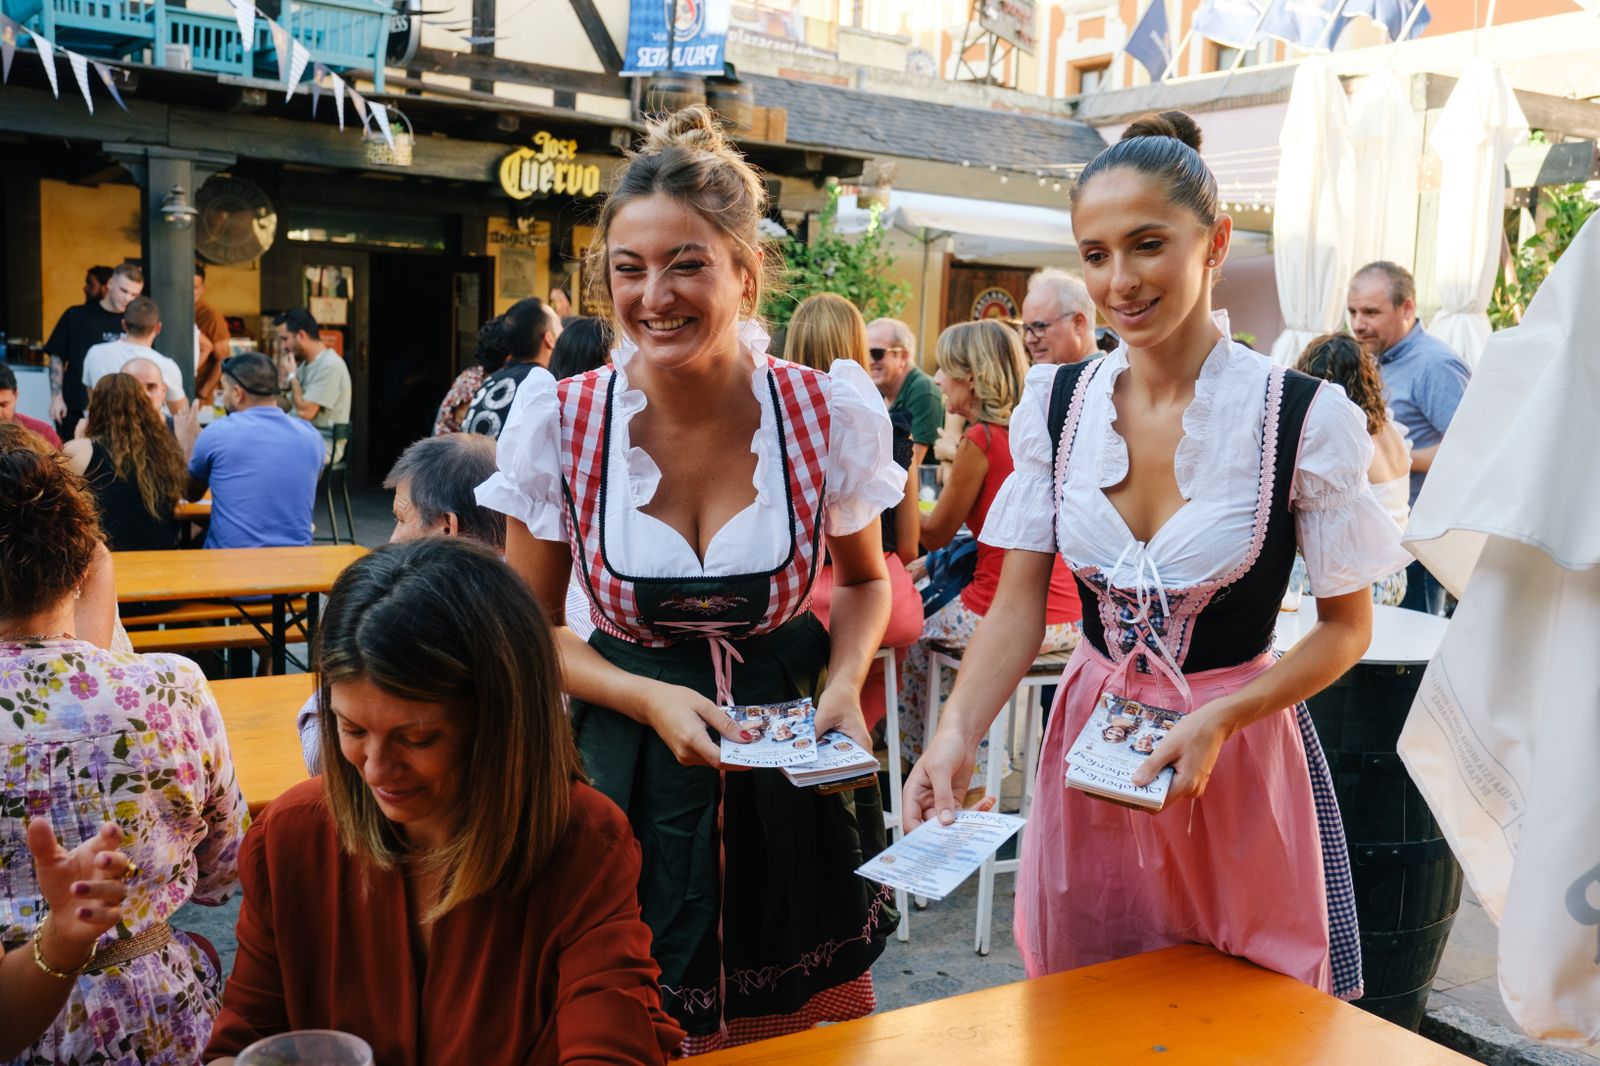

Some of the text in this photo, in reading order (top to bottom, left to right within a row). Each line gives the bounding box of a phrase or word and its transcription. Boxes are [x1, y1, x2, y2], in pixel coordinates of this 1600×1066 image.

[532, 130, 578, 161] Jose
[499, 146, 601, 200] Cuervo
[726, 750, 815, 767] Oktoberfest
[1071, 763, 1162, 794] Oktoberfest
